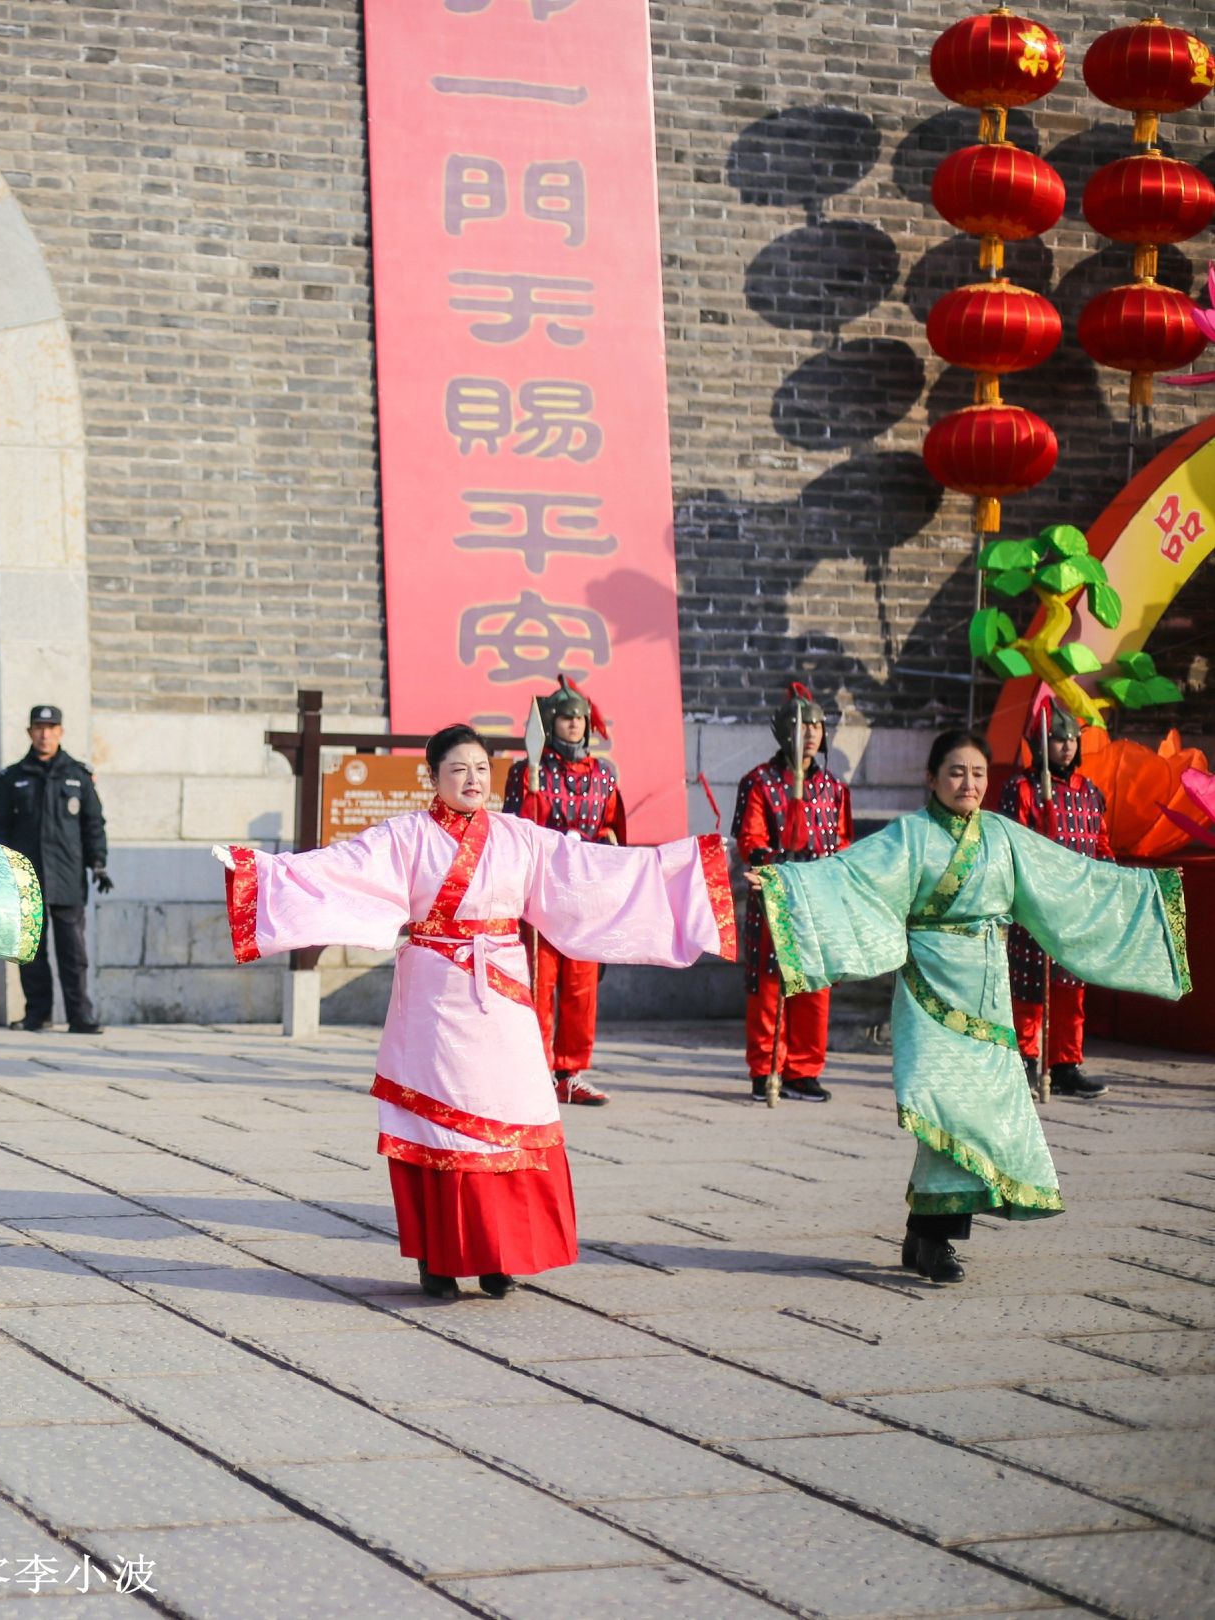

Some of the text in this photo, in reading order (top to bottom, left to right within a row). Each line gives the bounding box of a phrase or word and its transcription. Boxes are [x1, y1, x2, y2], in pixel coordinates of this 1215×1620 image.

[430, 0, 620, 782] 一門天賜平安
